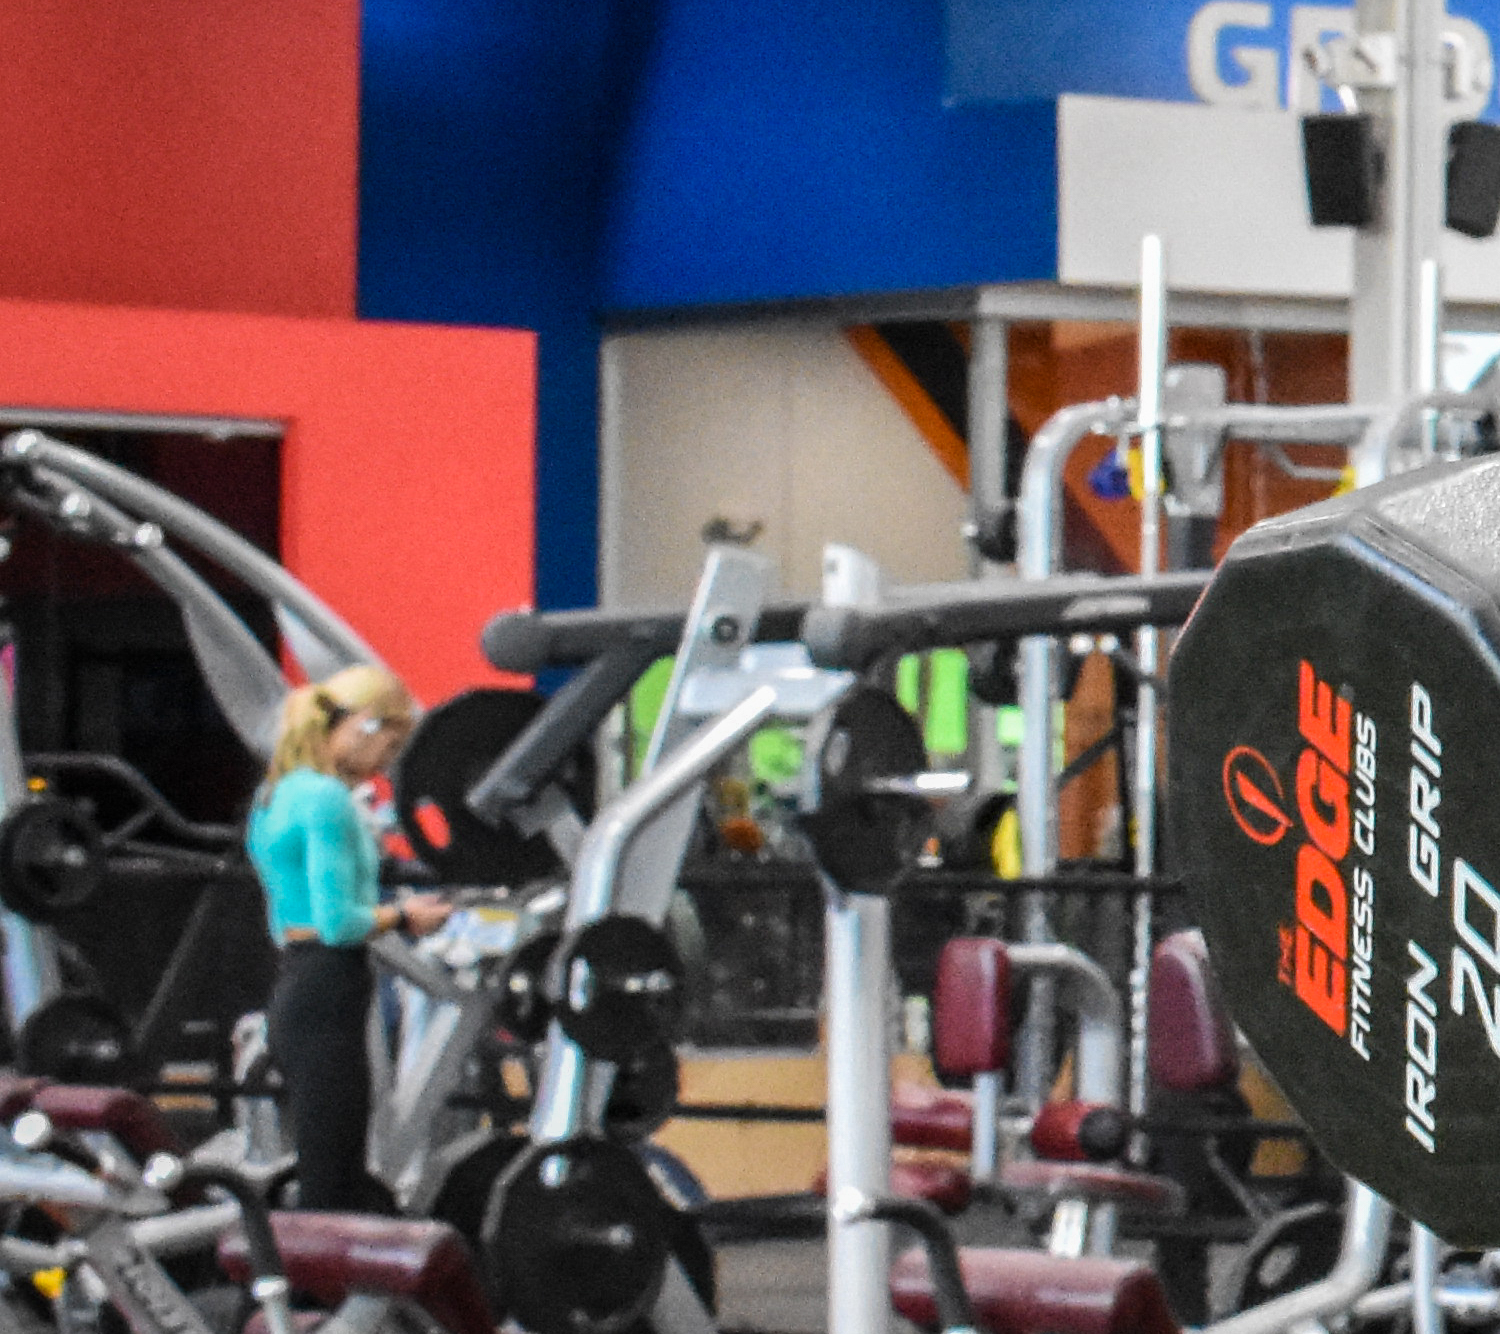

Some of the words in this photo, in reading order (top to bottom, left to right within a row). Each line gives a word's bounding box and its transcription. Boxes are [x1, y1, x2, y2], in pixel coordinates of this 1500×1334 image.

[1296, 659, 1353, 1038] EDGE
[1353, 711, 1377, 857] CLUBS
[1407, 680, 1443, 898] GRIP
[1350, 866, 1375, 1062] FITNESS
[1405, 938, 1439, 1154] IRON
